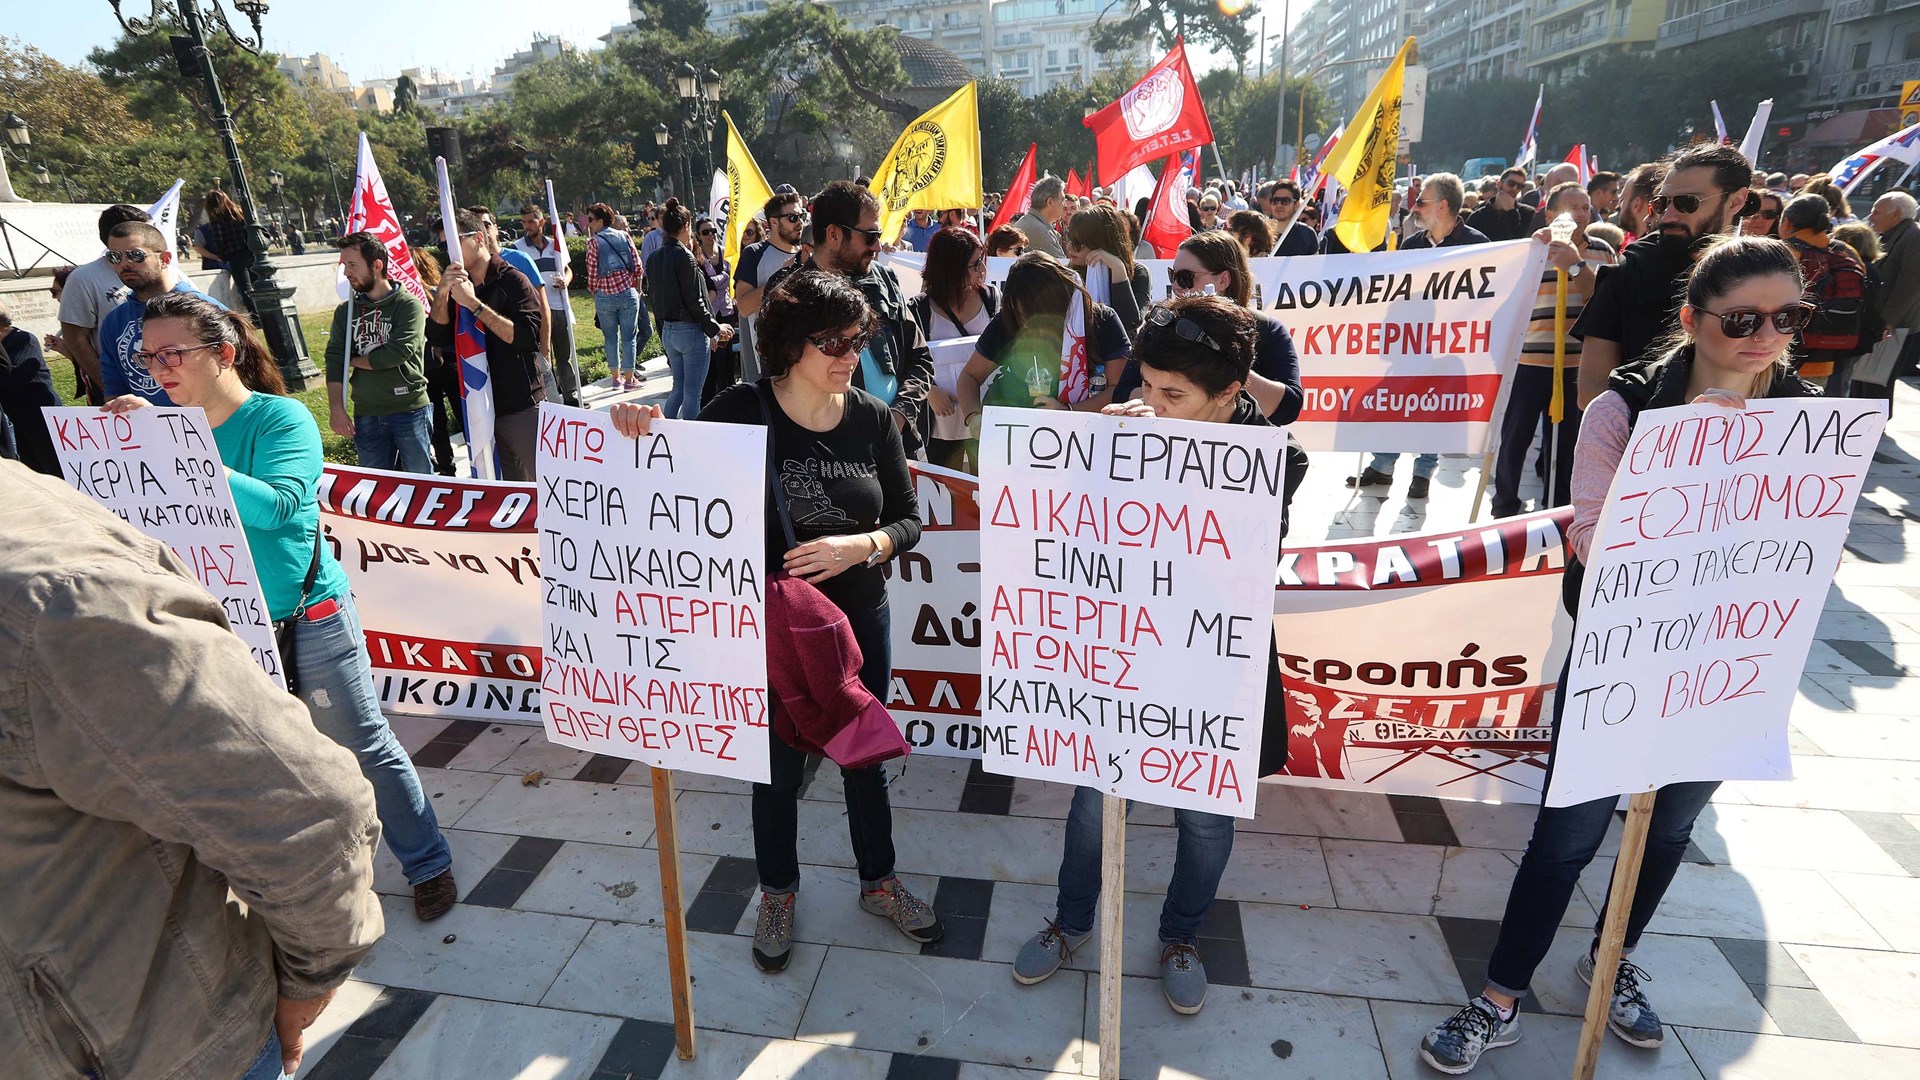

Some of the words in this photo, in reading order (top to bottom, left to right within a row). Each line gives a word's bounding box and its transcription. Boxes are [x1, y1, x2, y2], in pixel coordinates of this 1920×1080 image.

[1275, 273, 1412, 311] ΔΟΥΛΕΙΑ
[1423, 266, 1496, 301] ΜΑΣ
[1303, 320, 1492, 355] ΚΥΒΕΡΝΗΣΗ
[1302, 388, 1355, 412] ΠΟΥ
[1361, 387, 1485, 418] «Ευρώπη»
[157, 413, 207, 451] ΤΑ
[1629, 410, 1774, 475] ΕΜΠΡΟΣ
[1777, 409, 1882, 457] ΛΑΕ
[68, 458, 167, 499] ΧΕΡΙΑ
[175, 457, 216, 478] ΑΠΟ
[186, 479, 217, 498] ΤΗ
[138, 504, 236, 529] ΚΑΤΟΙΚΙΑ
[544, 475, 627, 526] ΧΕΡΙΑ
[650, 493, 733, 539] ΑΠΟ
[357, 537, 430, 573] μας
[434, 550, 489, 575] να
[494, 546, 541, 585] γί
[545, 528, 577, 572] ΤΟ
[1034, 538, 1123, 594] ΕΙΝΑΙ
[1152, 560, 1174, 597] Η
[1275, 517, 1567, 587] ΚΡΑΤΙΑ
[546, 577, 597, 618] ΣΤΗΝ
[616, 590, 760, 640] ΑΠΕΡΓΙΑ
[911, 602, 981, 648] Δύ
[990, 584, 1163, 647] ΑΠΕΡΓΙΑ
[1186, 609, 1253, 659] ΜΕ
[1651, 612, 1704, 653] ΤΟΥ
[1702, 597, 1800, 645] ΛΑΟΥ
[378, 637, 536, 678] ΙΚΑΤΟ
[551, 622, 593, 664] ΚΑΙ
[616, 634, 682, 672] ΤΙΣ
[1275, 642, 1529, 690] τροπής
[987, 675, 1245, 752] ΚΑΤΑΚΤΗΘΗΚΕ
[1573, 681, 1637, 731] ΤΟ
[1661, 653, 1773, 719] ΒΙΟΣ
[549, 702, 737, 761] ΕΛΕΥΘΕΡΙΕΣ
[982, 724, 1019, 757] ΜΕ
[1024, 724, 1101, 778] ΑΙΜΑ
[1139, 746, 1244, 803] ΘΥΣΙΑ
